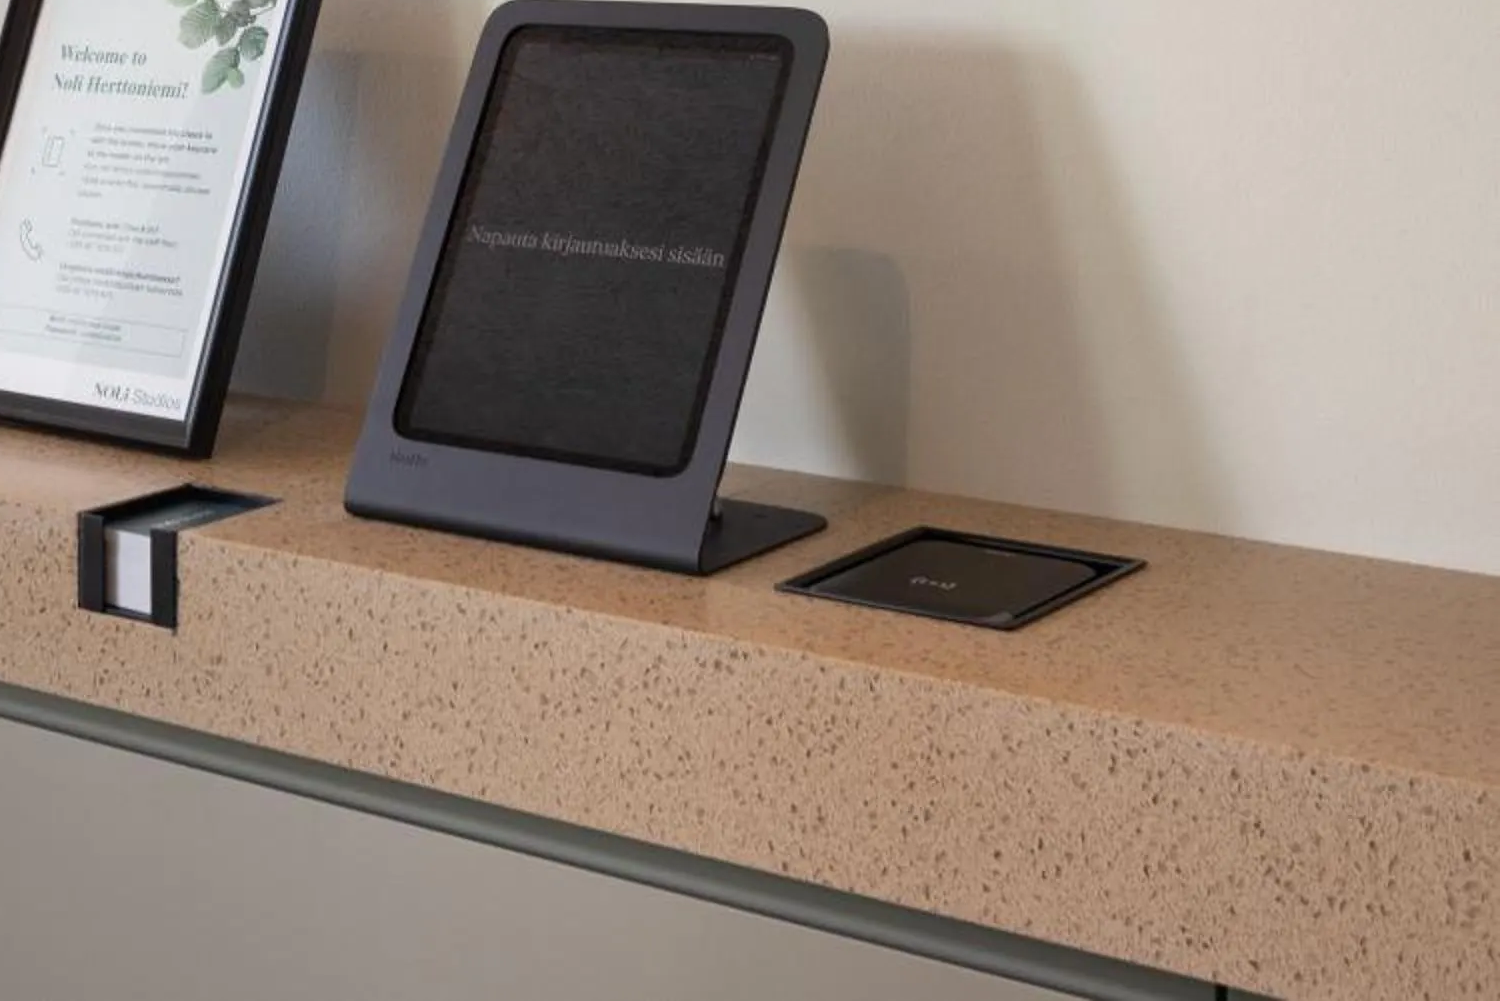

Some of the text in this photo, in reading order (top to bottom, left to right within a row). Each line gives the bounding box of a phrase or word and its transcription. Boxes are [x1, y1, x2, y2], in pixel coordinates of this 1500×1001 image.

[60, 43, 147, 67] Welcome to
[53, 72, 84, 92] Noli
[467, 224, 539, 249] Napauta
[666, 246, 726, 268] sisään
[131, 387, 181, 408] Studios
